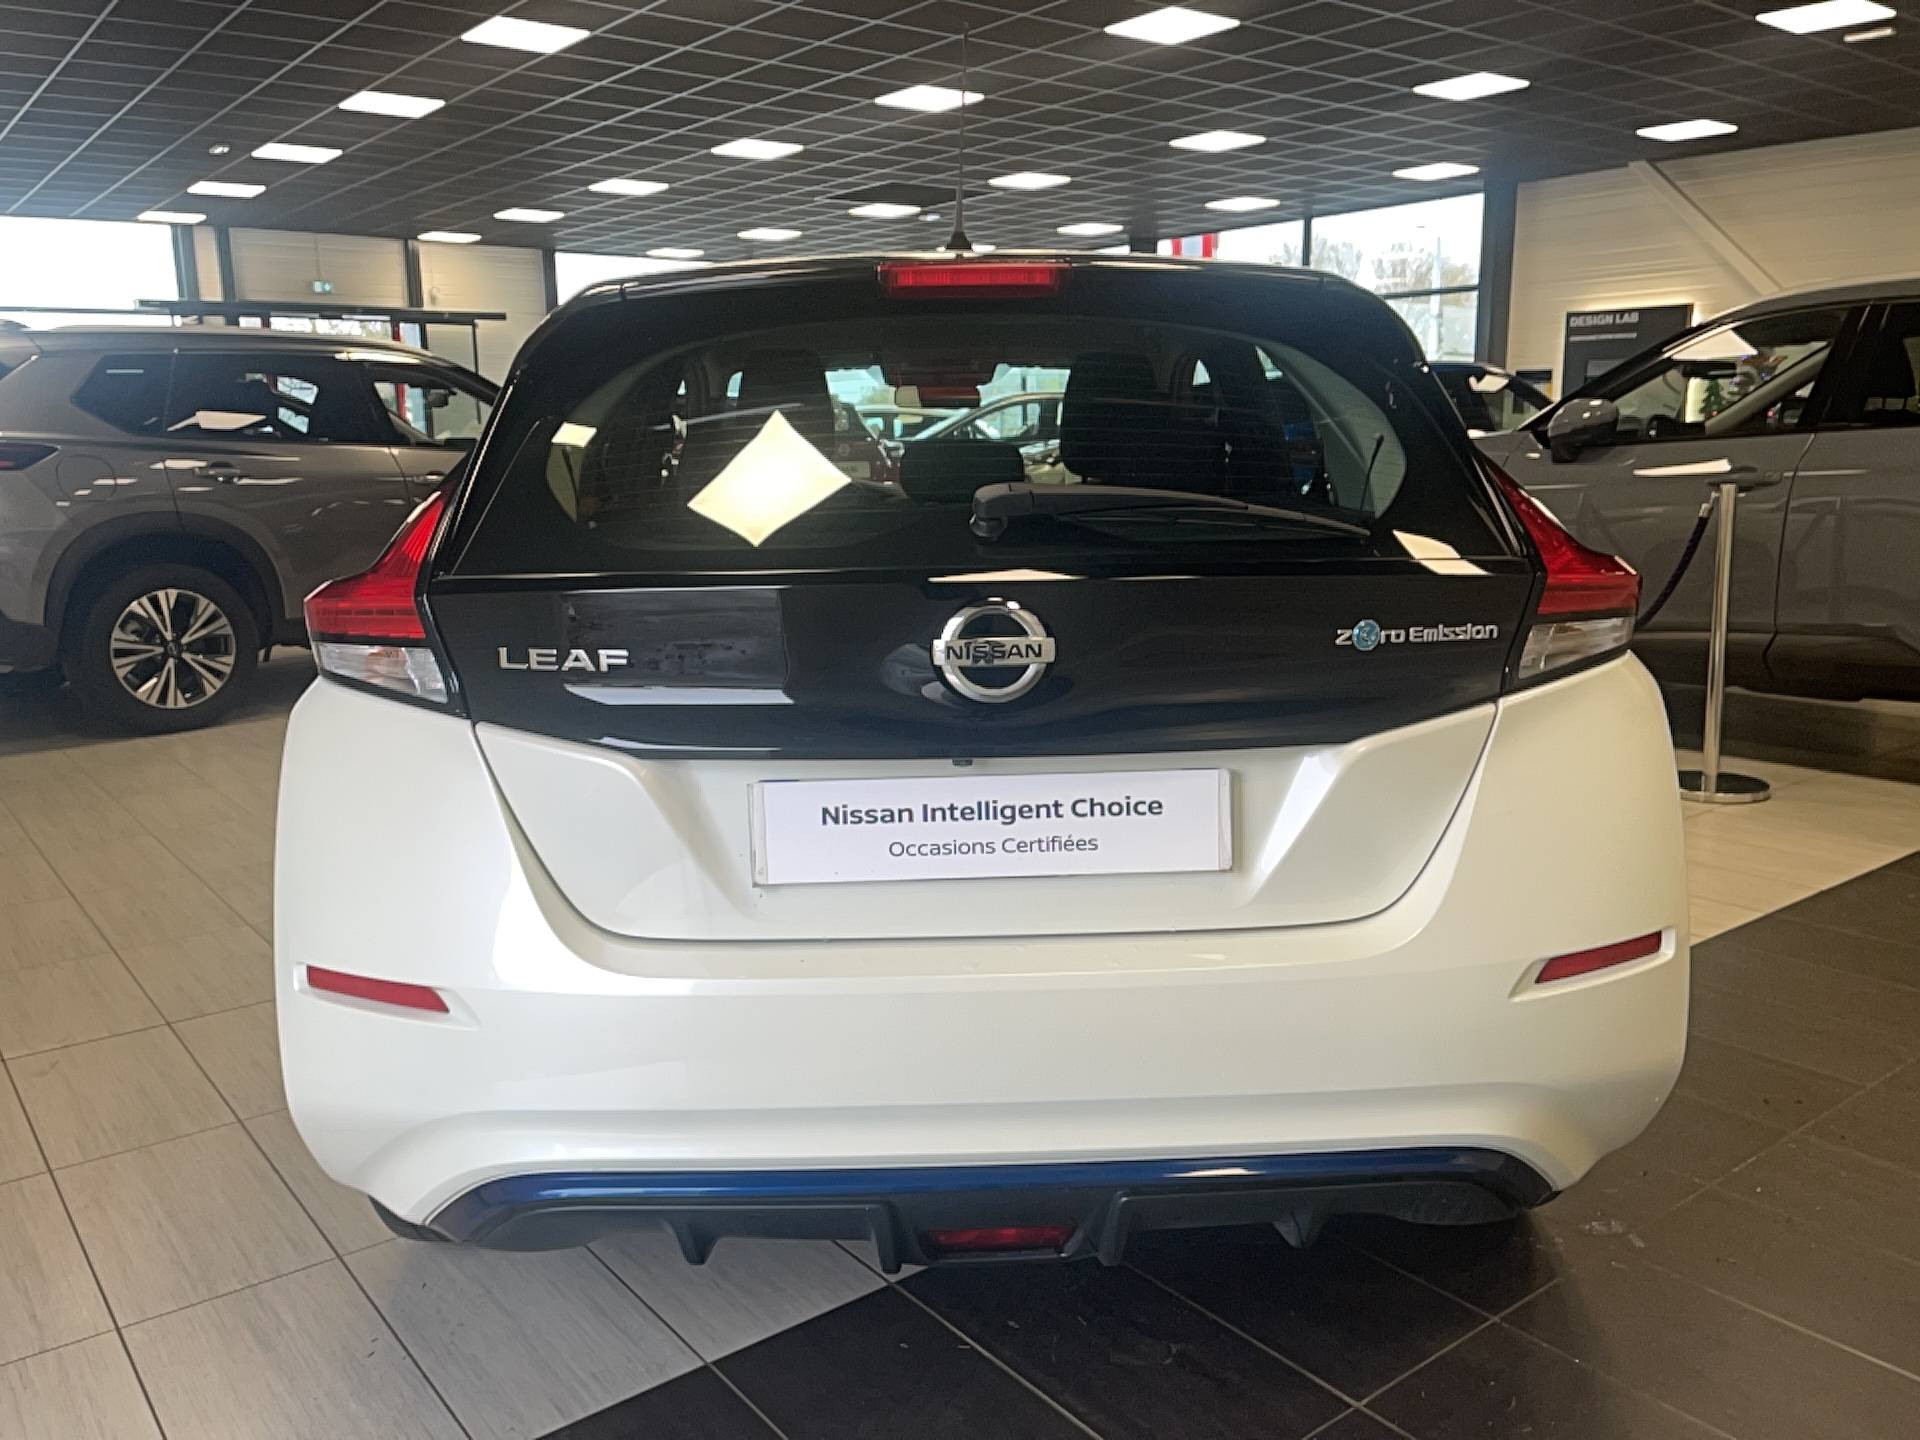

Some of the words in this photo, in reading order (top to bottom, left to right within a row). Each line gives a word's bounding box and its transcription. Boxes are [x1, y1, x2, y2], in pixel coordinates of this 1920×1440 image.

[1570, 314, 1613, 328] DESIGN
[1615, 312, 1640, 324] LAB
[1409, 623, 1499, 643] Emission
[497, 646, 630, 672] LEAF
[946, 643, 1042, 660] NISSAN
[821, 804, 914, 826] Nissan
[922, 797, 1064, 825] Intelligent
[1071, 795, 1164, 818] Choice
[888, 839, 996, 857] Occasions
[1001, 834, 1099, 855] Certifiées
